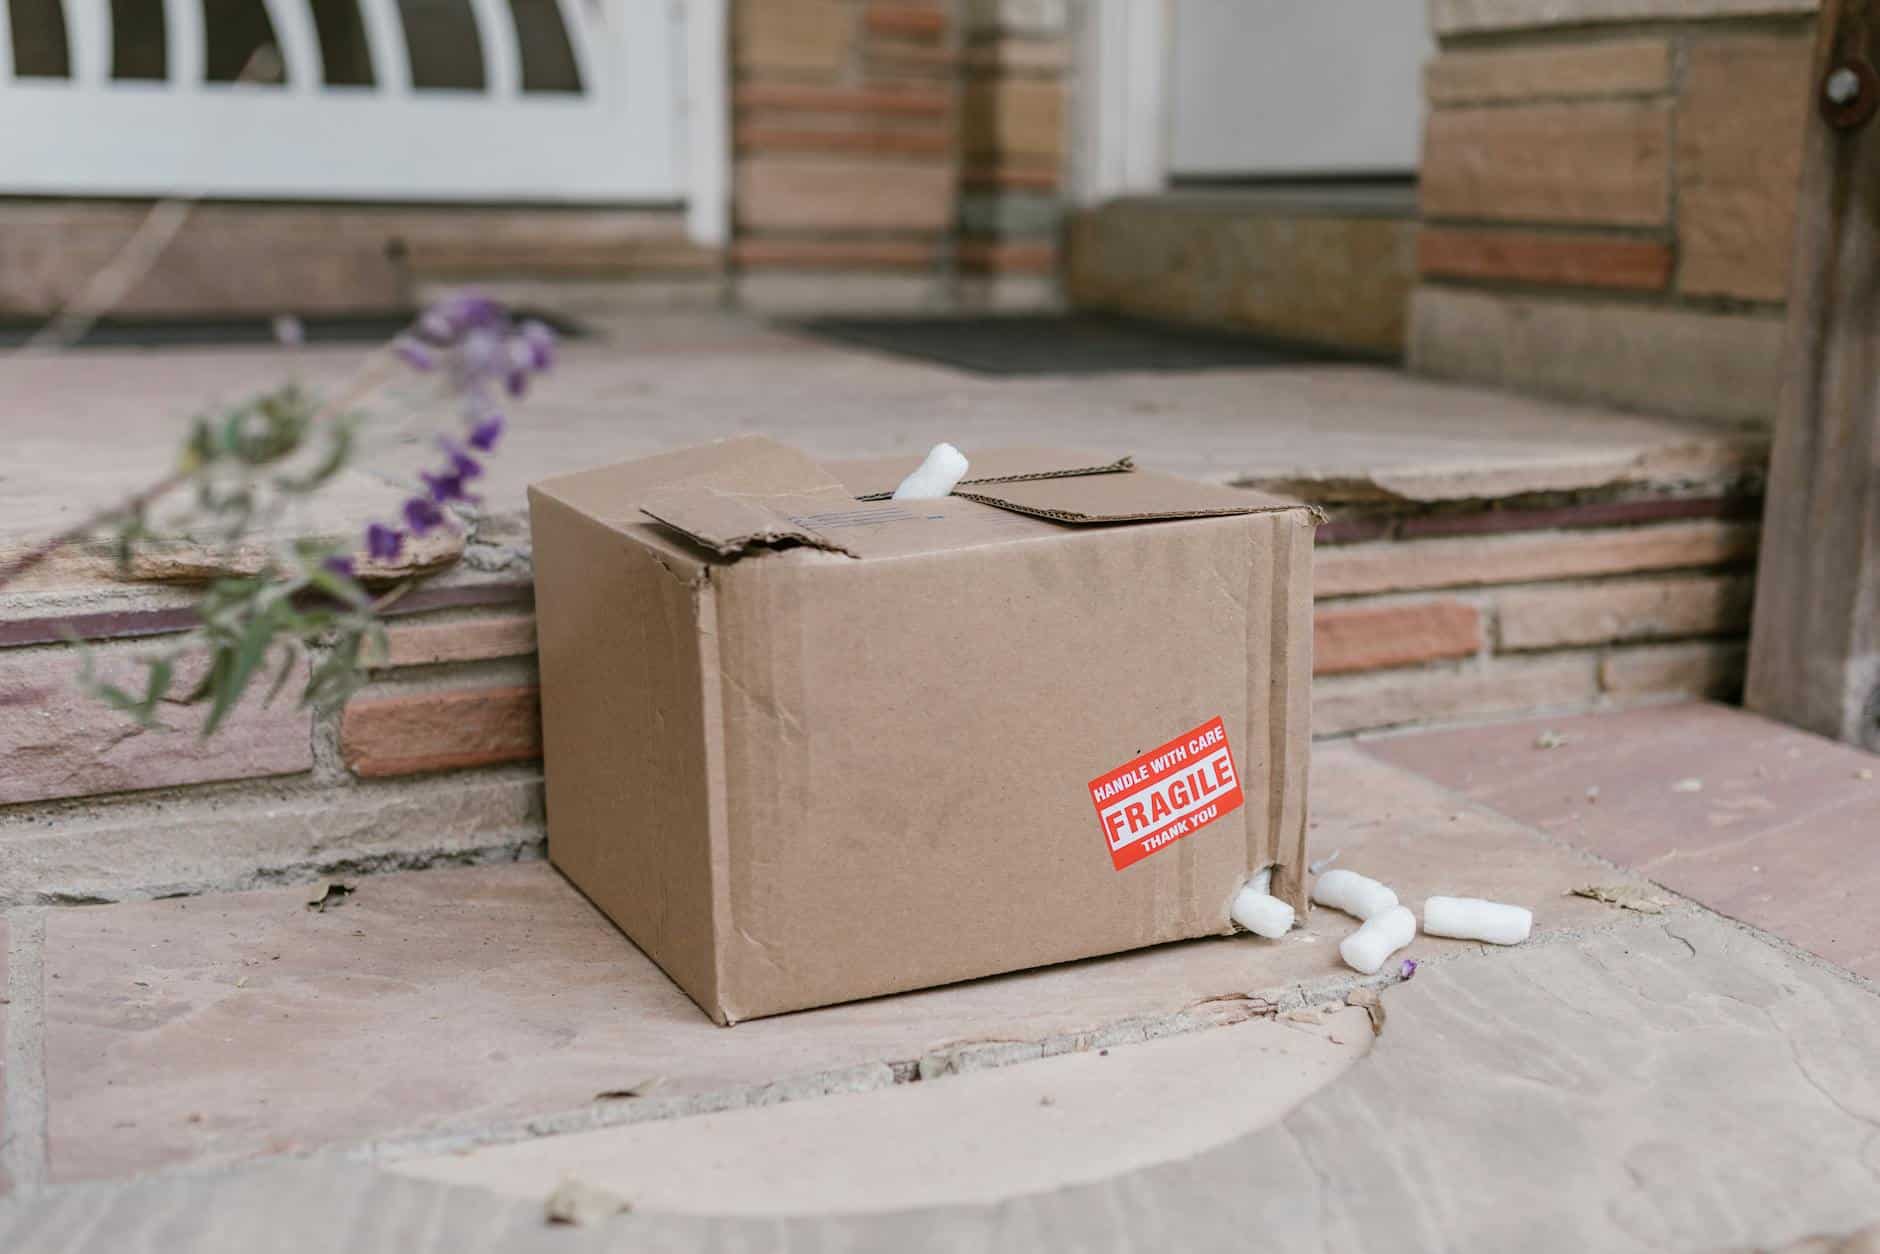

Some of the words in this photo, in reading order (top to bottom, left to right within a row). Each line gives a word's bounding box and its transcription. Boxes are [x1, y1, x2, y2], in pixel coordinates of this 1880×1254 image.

[1093, 765, 1149, 803] HANDLE
[1150, 746, 1187, 774] WITH
[1188, 726, 1224, 755] CARE
[1106, 755, 1233, 843] FRAGILE
[1141, 820, 1189, 852] THANK
[1189, 805, 1217, 827] YOU
